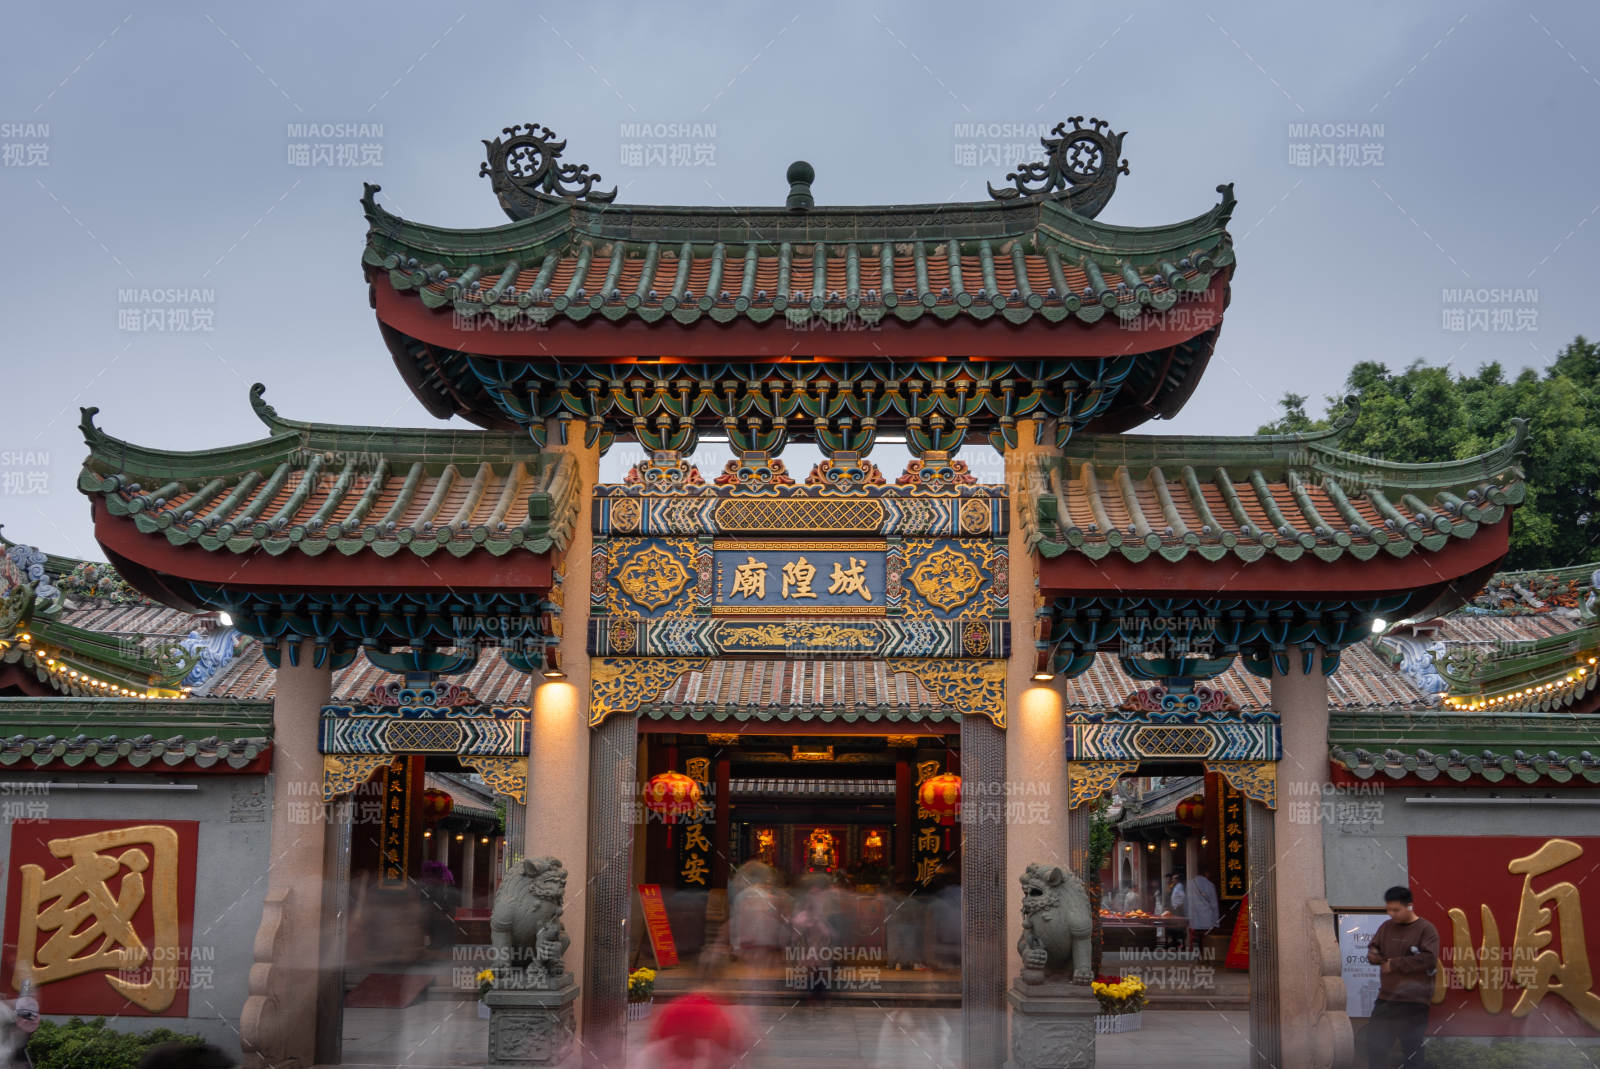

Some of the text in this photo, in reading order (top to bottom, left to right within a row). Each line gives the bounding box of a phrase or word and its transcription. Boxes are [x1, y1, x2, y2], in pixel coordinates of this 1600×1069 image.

[915, 760, 940, 887] 風雨順
[11, 825, 179, 1013] 國
